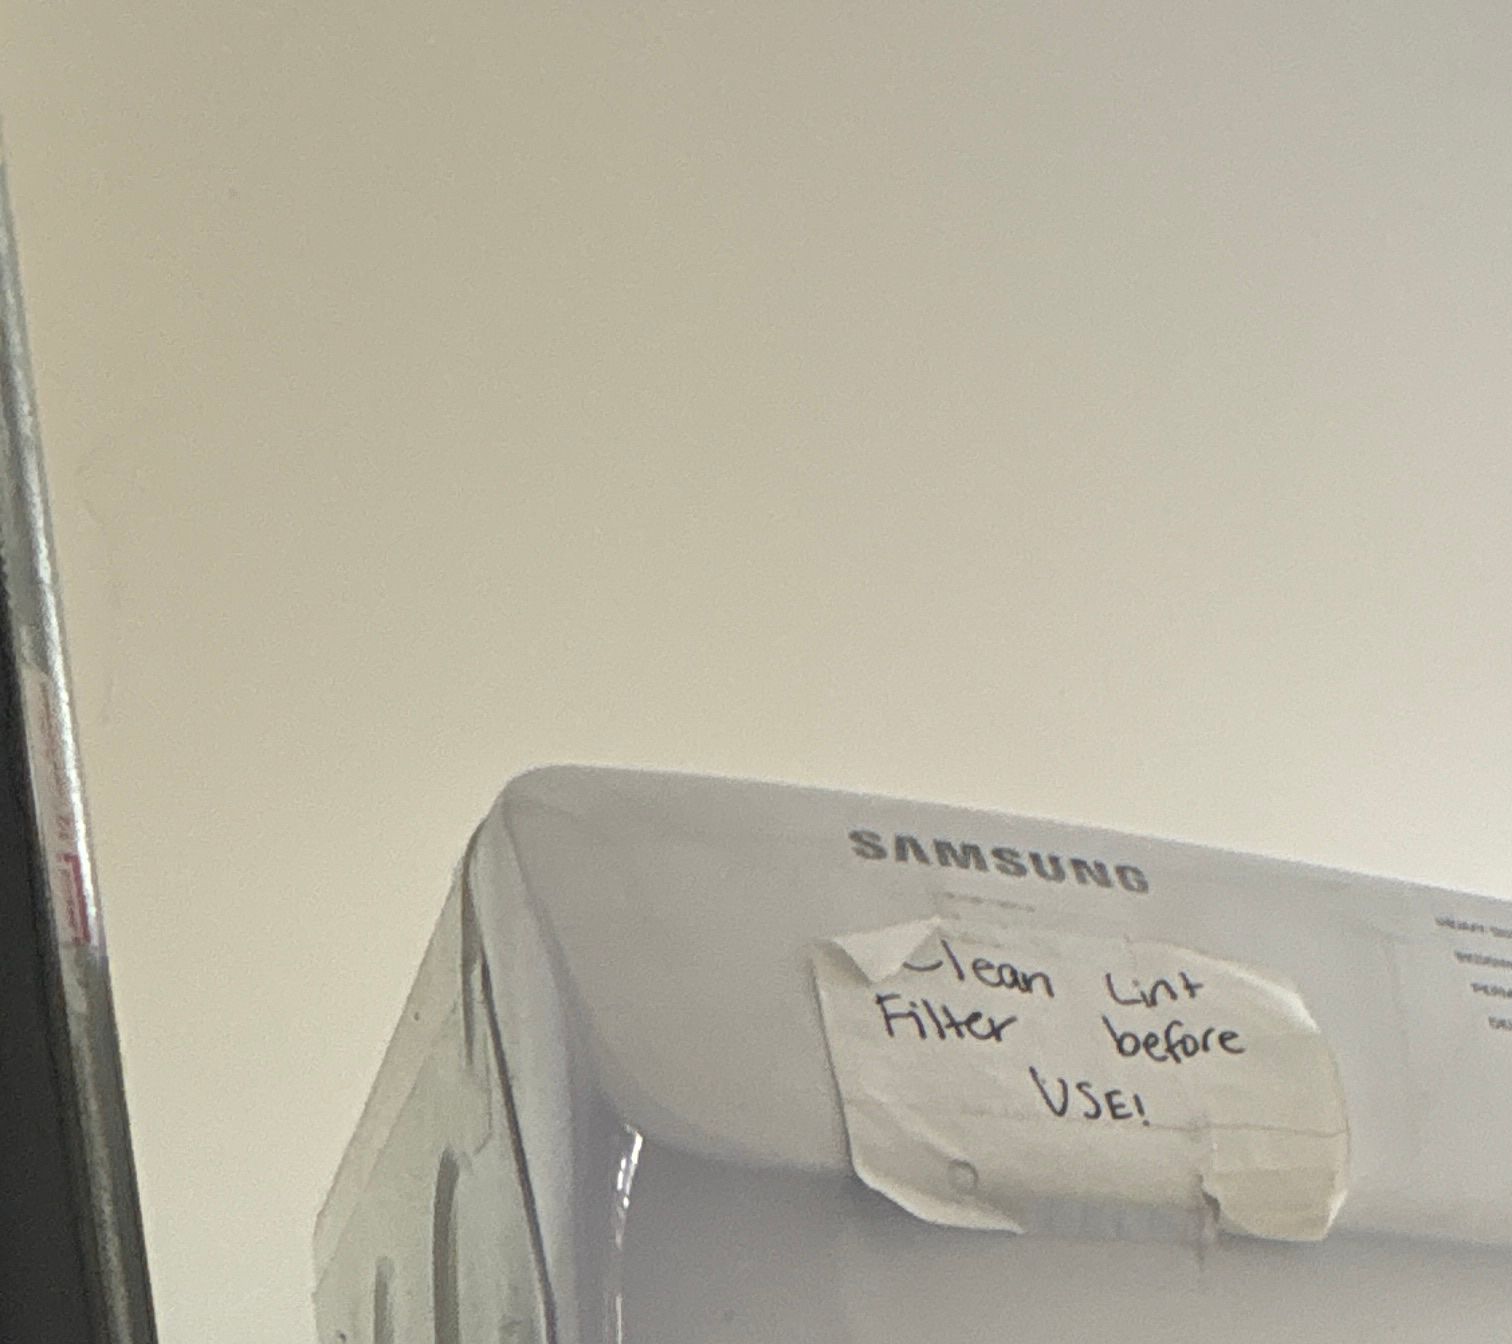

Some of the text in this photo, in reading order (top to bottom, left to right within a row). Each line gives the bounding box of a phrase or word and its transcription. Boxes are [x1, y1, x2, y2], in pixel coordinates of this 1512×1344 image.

[848, 829, 1151, 895] SAMSUNG
[875, 992, 1246, 1064] Filter before
[1028, 1065, 1151, 1128] USE!
